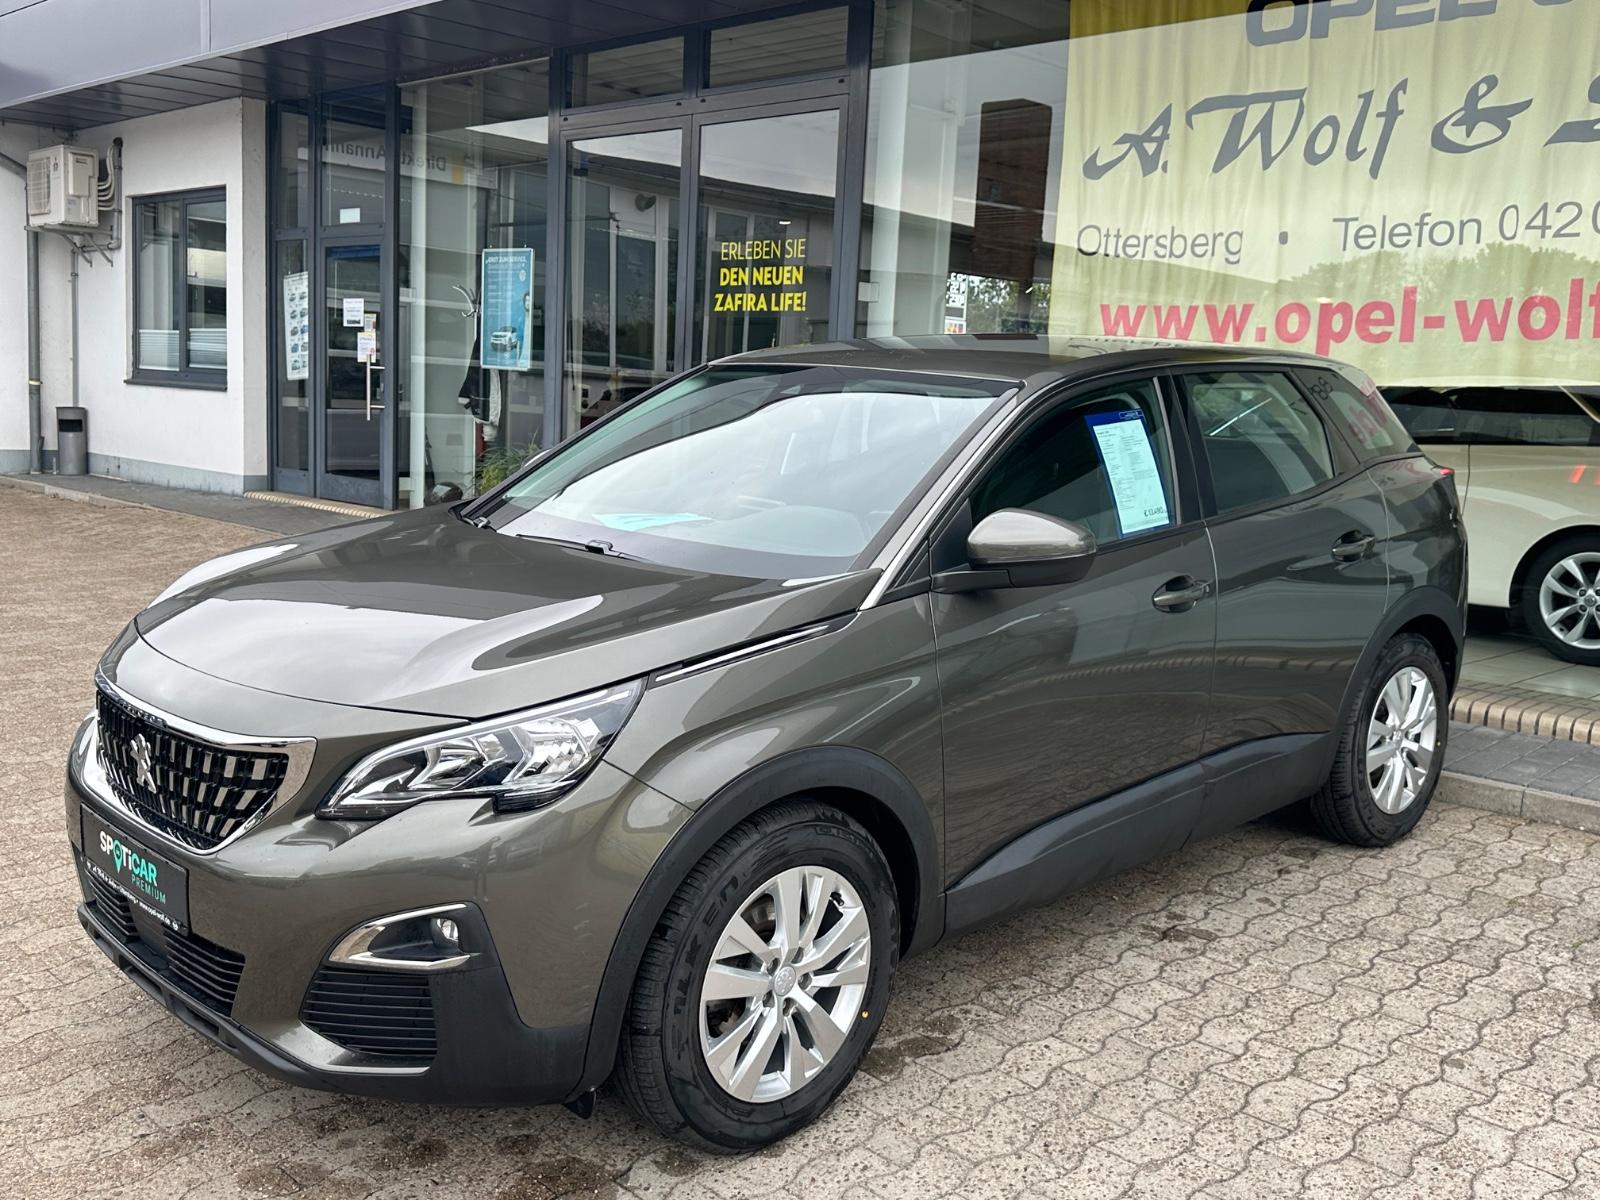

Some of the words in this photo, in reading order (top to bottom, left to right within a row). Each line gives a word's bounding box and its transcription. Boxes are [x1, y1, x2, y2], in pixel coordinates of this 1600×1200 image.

[1185, 77, 1409, 180] Wolf
[1430, 74, 1533, 154] &
[720, 240, 781, 261] ERLEBEN
[785, 238, 806, 260] SIE
[1076, 224, 1244, 264] Ottersberg
[1332, 213, 1482, 251] Telefon
[719, 266, 748, 287] DEN
[752, 265, 804, 286] NEUEN
[713, 293, 768, 313] ZAFIRA
[771, 291, 807, 312] LIFE!
[131, 874, 166, 905] PREMIUM
